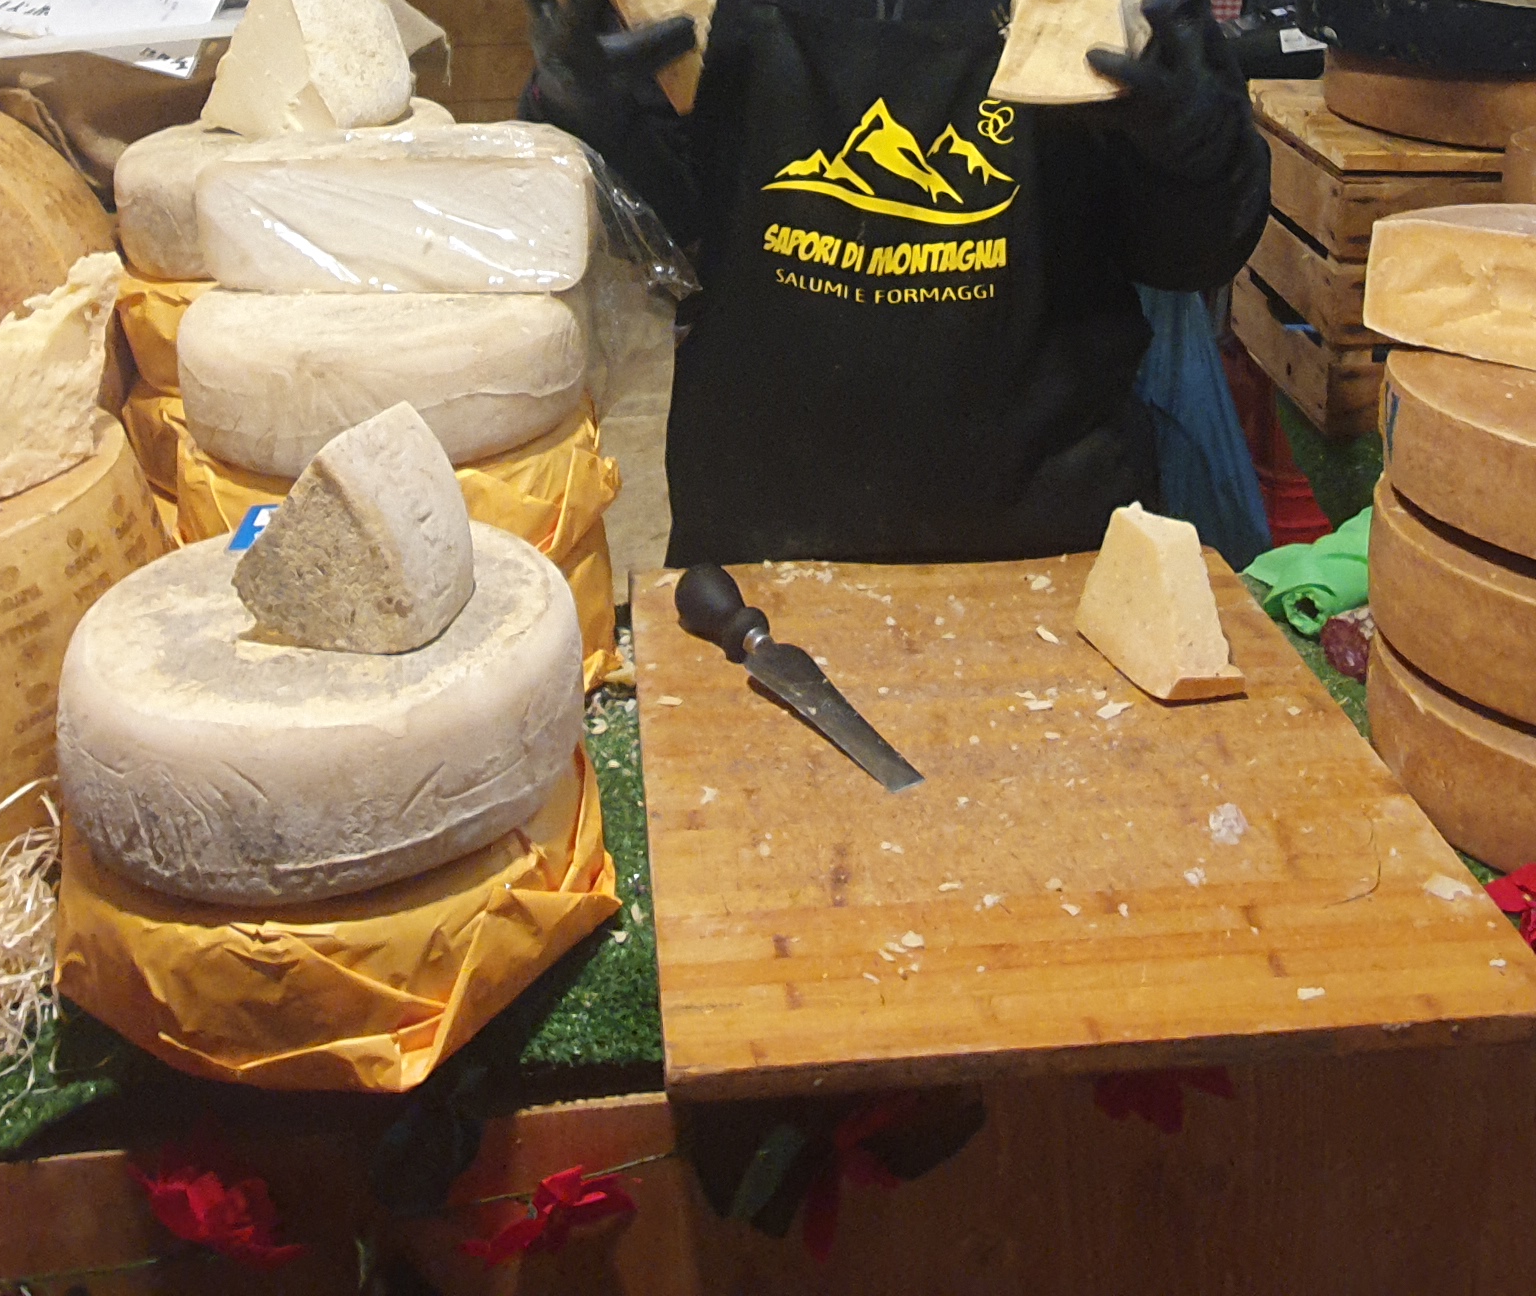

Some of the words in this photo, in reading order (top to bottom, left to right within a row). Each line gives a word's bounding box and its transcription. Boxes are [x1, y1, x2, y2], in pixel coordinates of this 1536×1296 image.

[763, 223, 842, 266] SAPORI
[841, 241, 865, 273] DI
[866, 237, 1007, 276] MONTAGNA
[775, 268, 848, 299] SALUMI
[855, 287, 866, 303] E
[874, 283, 995, 304] FORMAGGI
